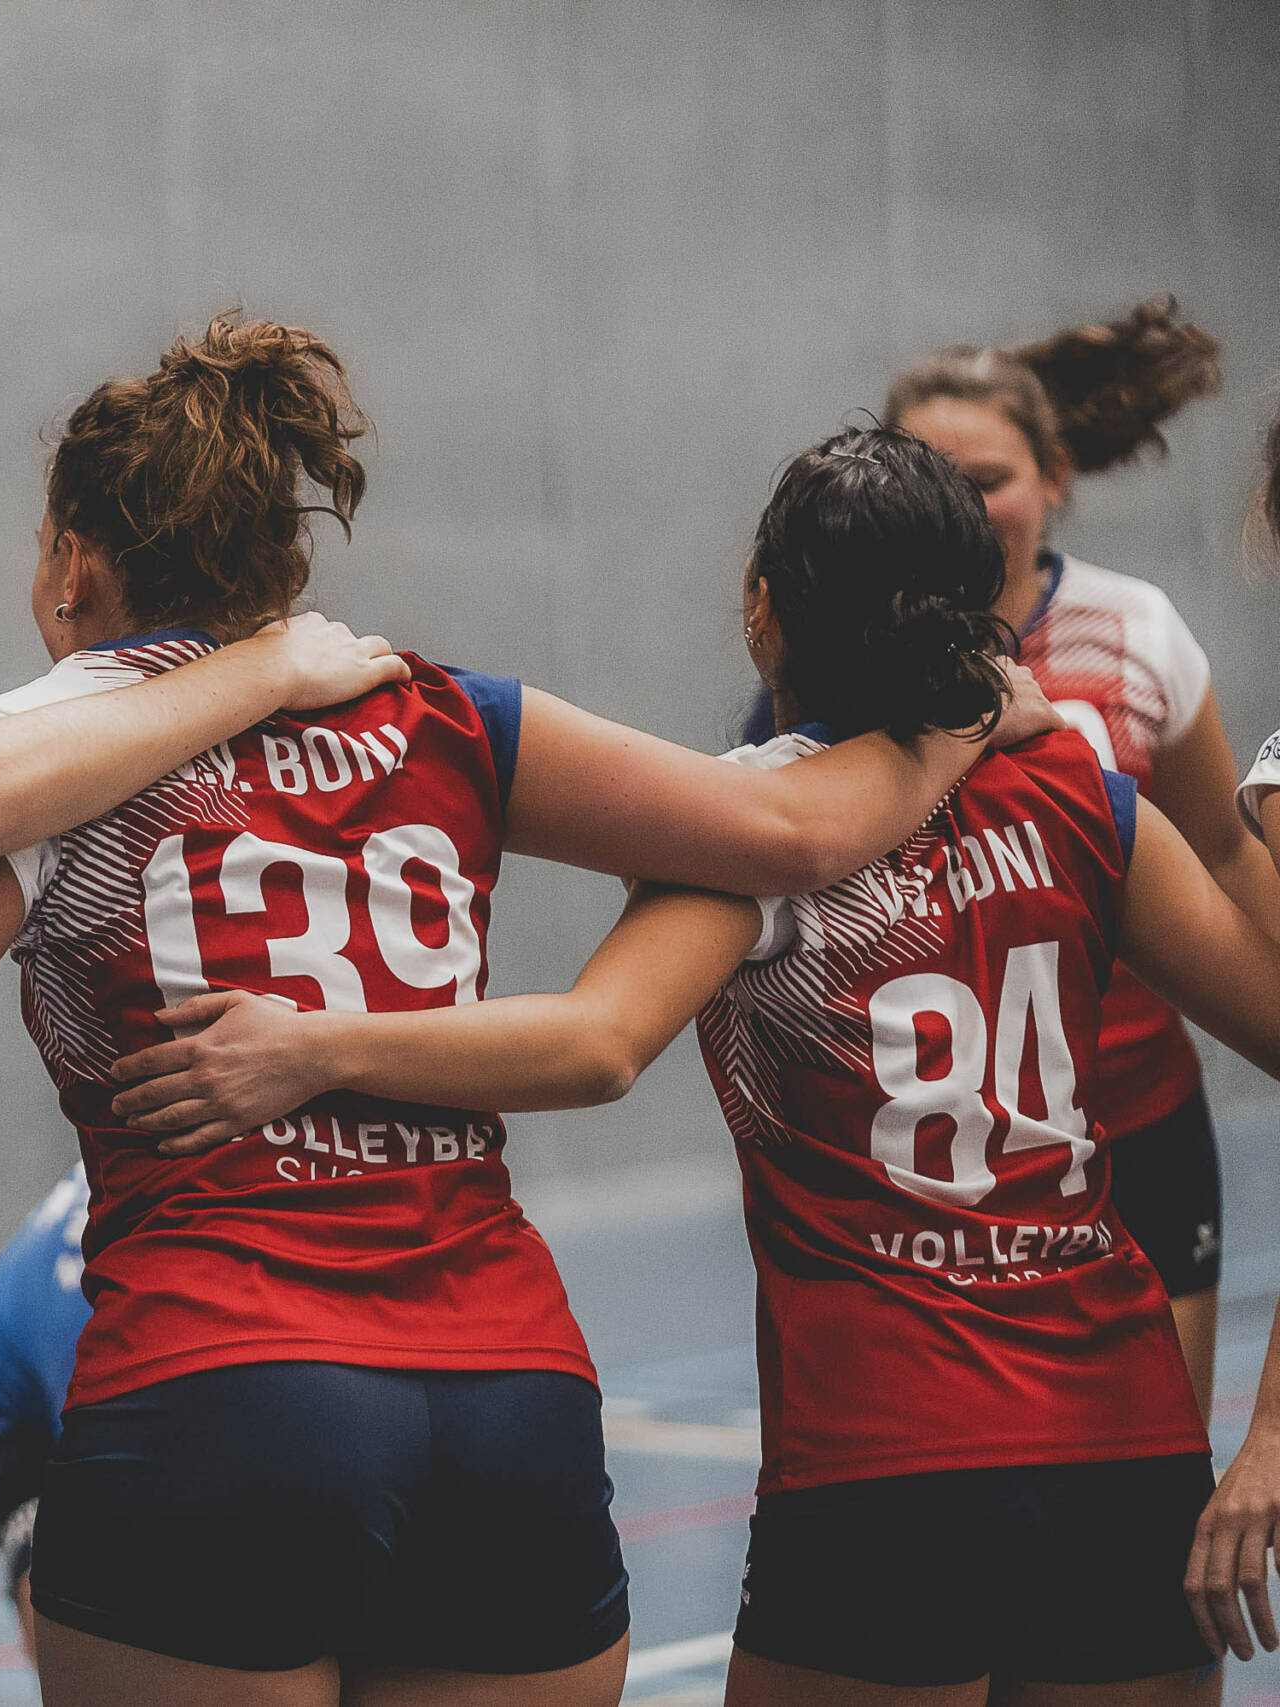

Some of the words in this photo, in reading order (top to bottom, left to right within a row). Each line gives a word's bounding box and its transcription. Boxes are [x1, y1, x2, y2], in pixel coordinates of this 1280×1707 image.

[261, 722, 408, 796] BONI
[141, 823, 482, 1041] 139
[869, 941, 1096, 1207] 84
